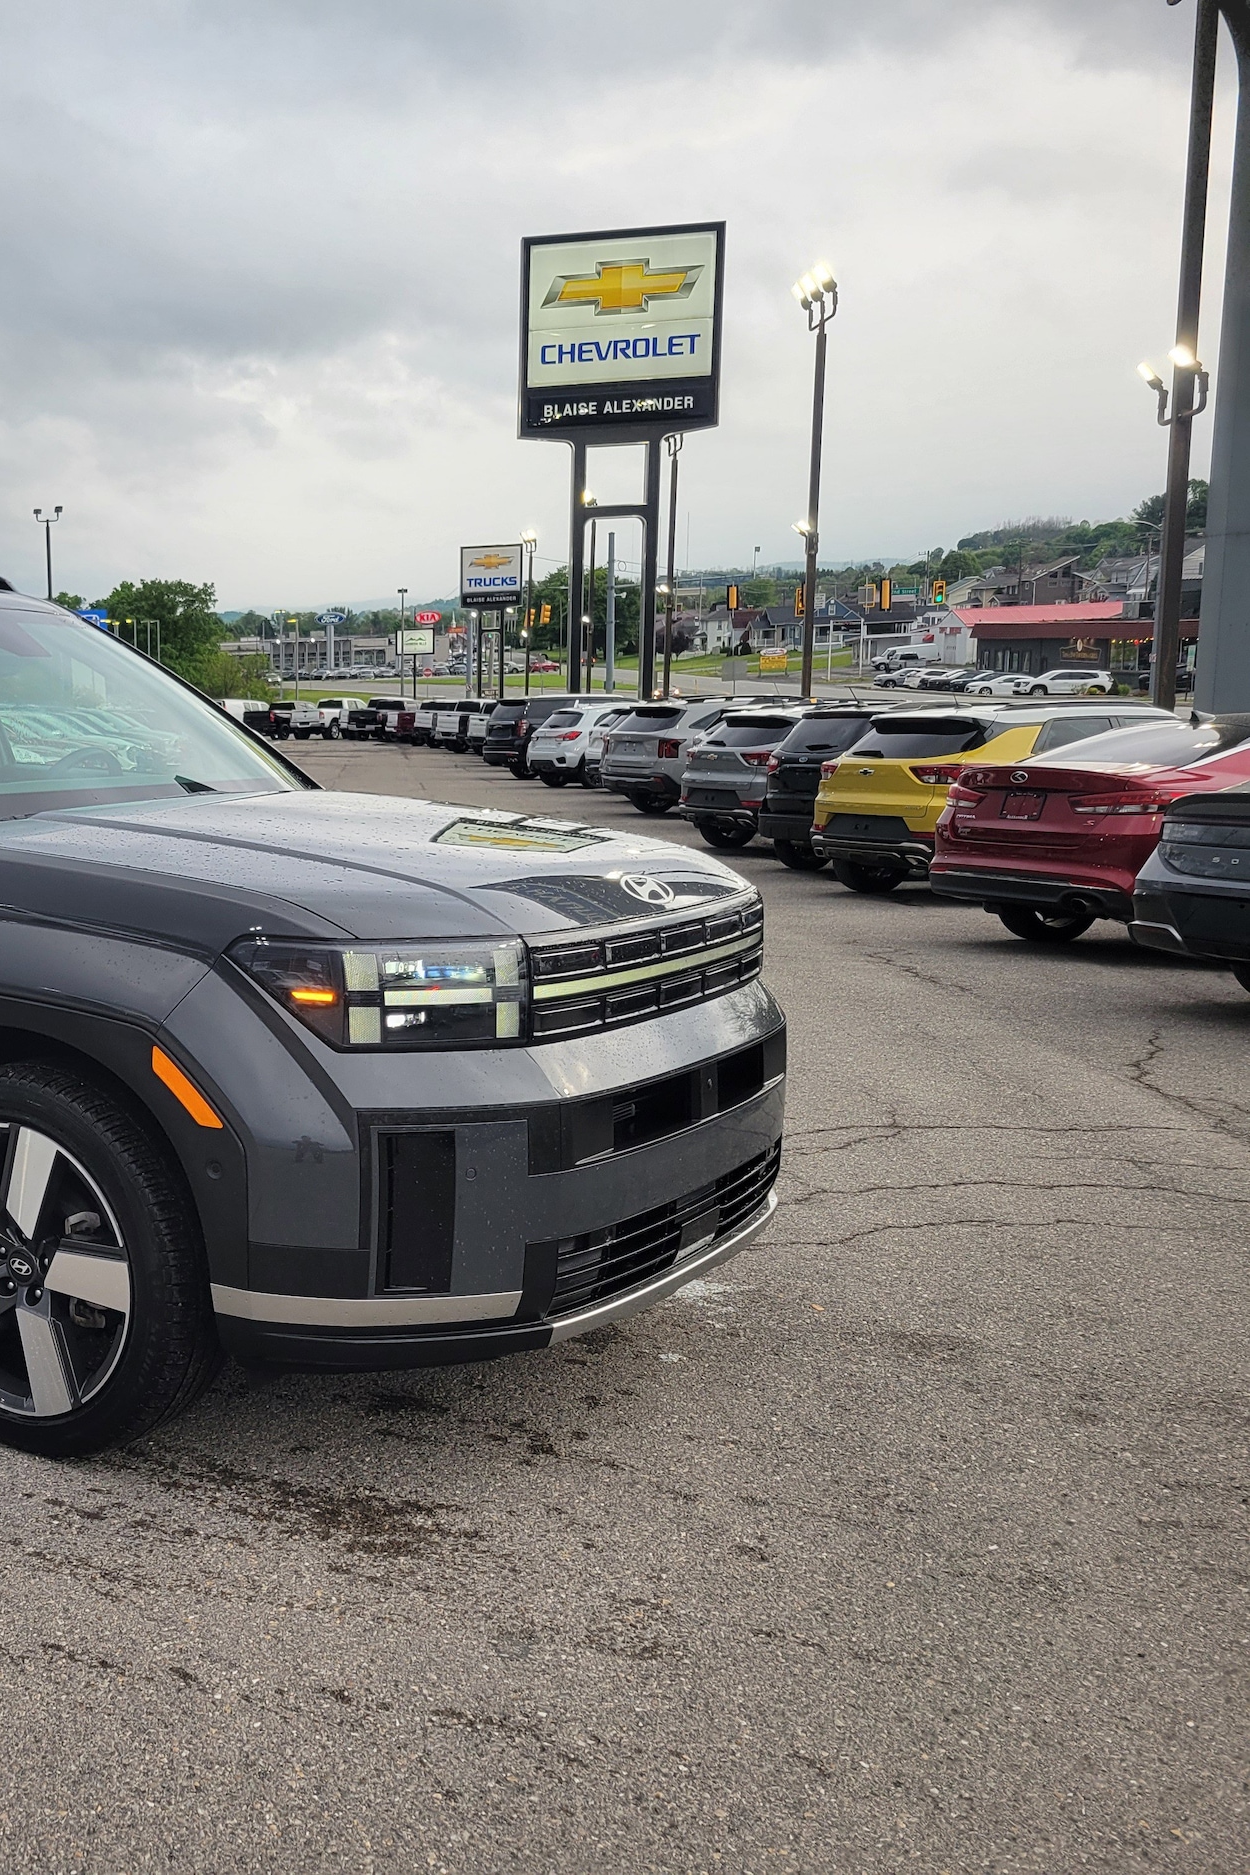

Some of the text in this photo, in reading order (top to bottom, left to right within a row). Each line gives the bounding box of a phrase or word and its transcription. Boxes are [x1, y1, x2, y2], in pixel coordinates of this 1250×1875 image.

[541, 334, 701, 365] CHEVROLET
[543, 396, 694, 418] BLAISE ALEXANDER
[466, 576, 517, 587] TRUCKS
[320, 614, 340, 623] Ford
[419, 613, 436, 621] KIA
